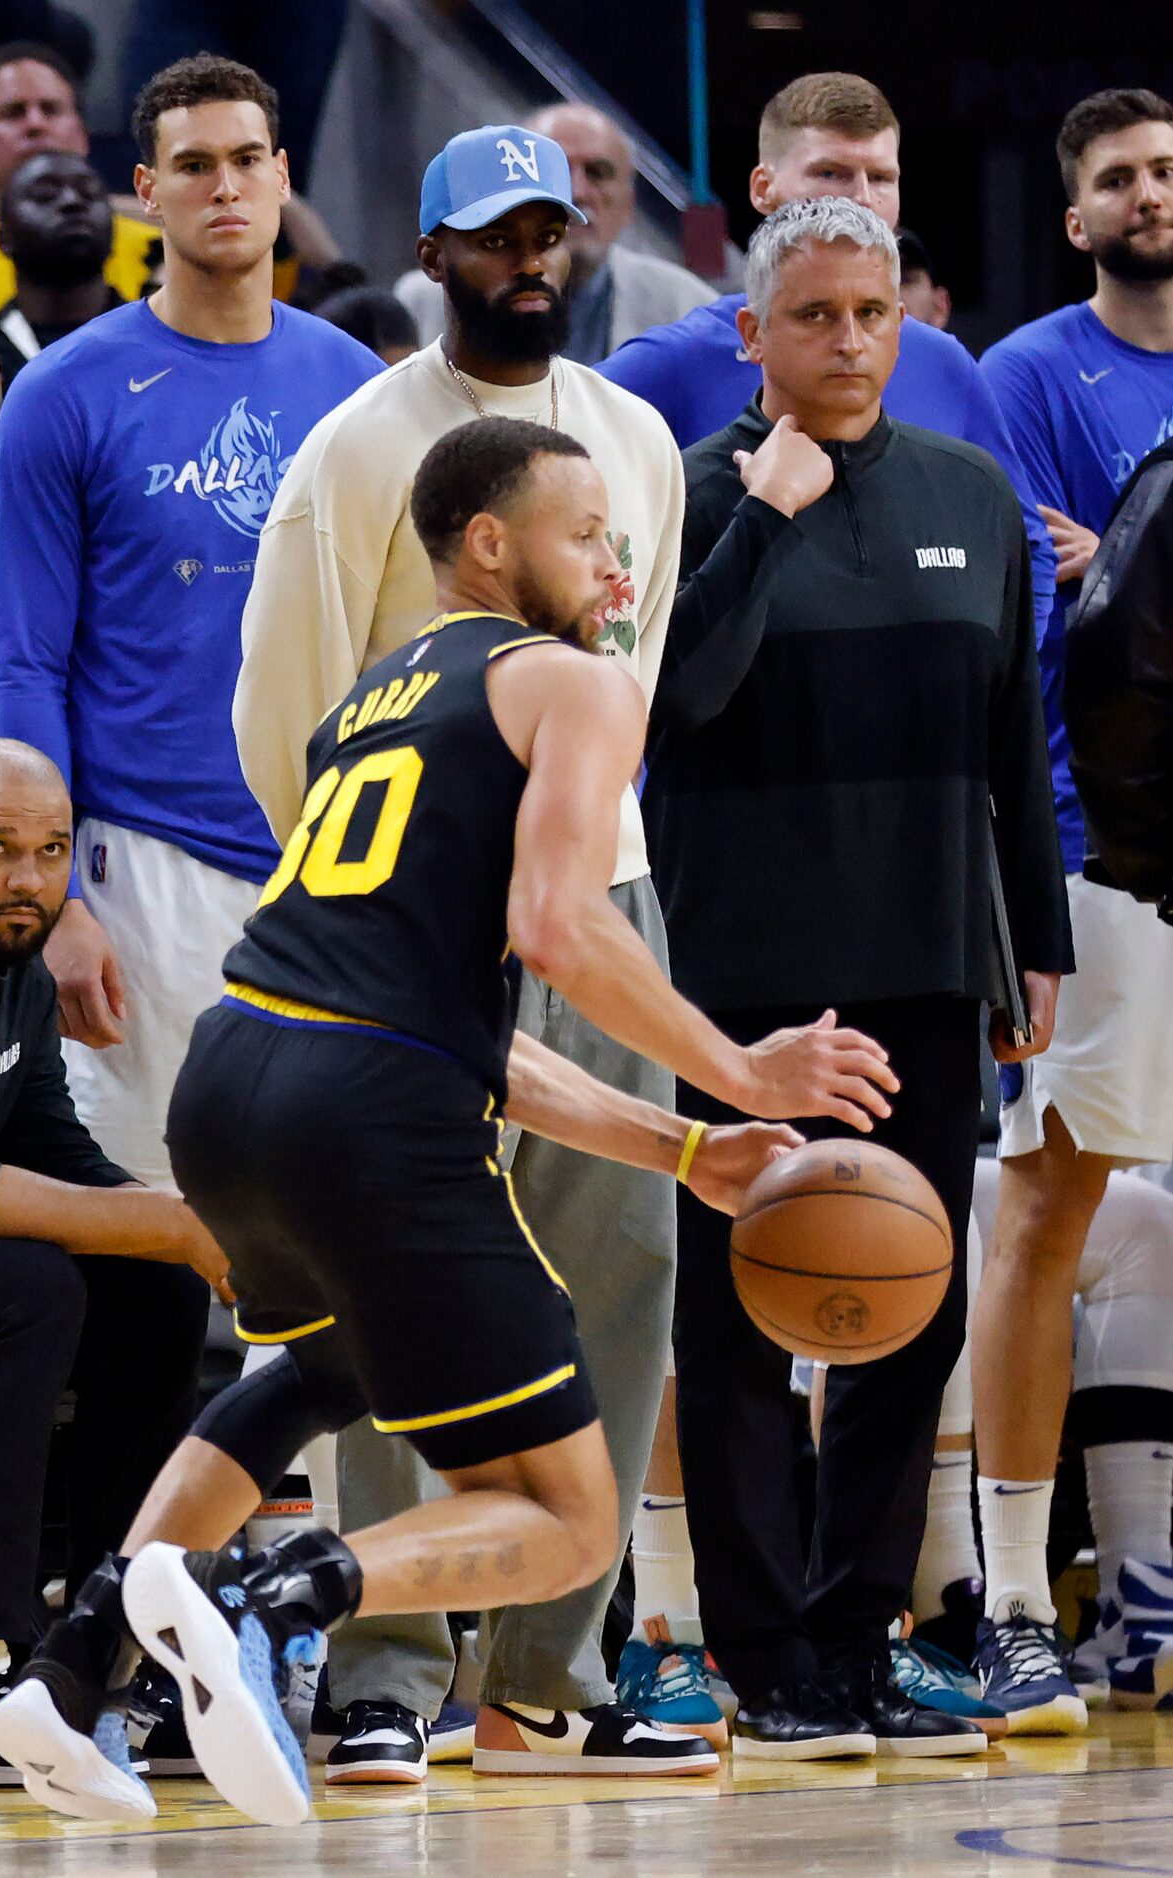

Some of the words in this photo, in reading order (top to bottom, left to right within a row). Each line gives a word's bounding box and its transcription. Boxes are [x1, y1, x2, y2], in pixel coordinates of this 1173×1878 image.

[496, 139, 540, 182] N
[915, 547, 967, 569] DALLAS
[337, 671, 441, 744] CURRY
